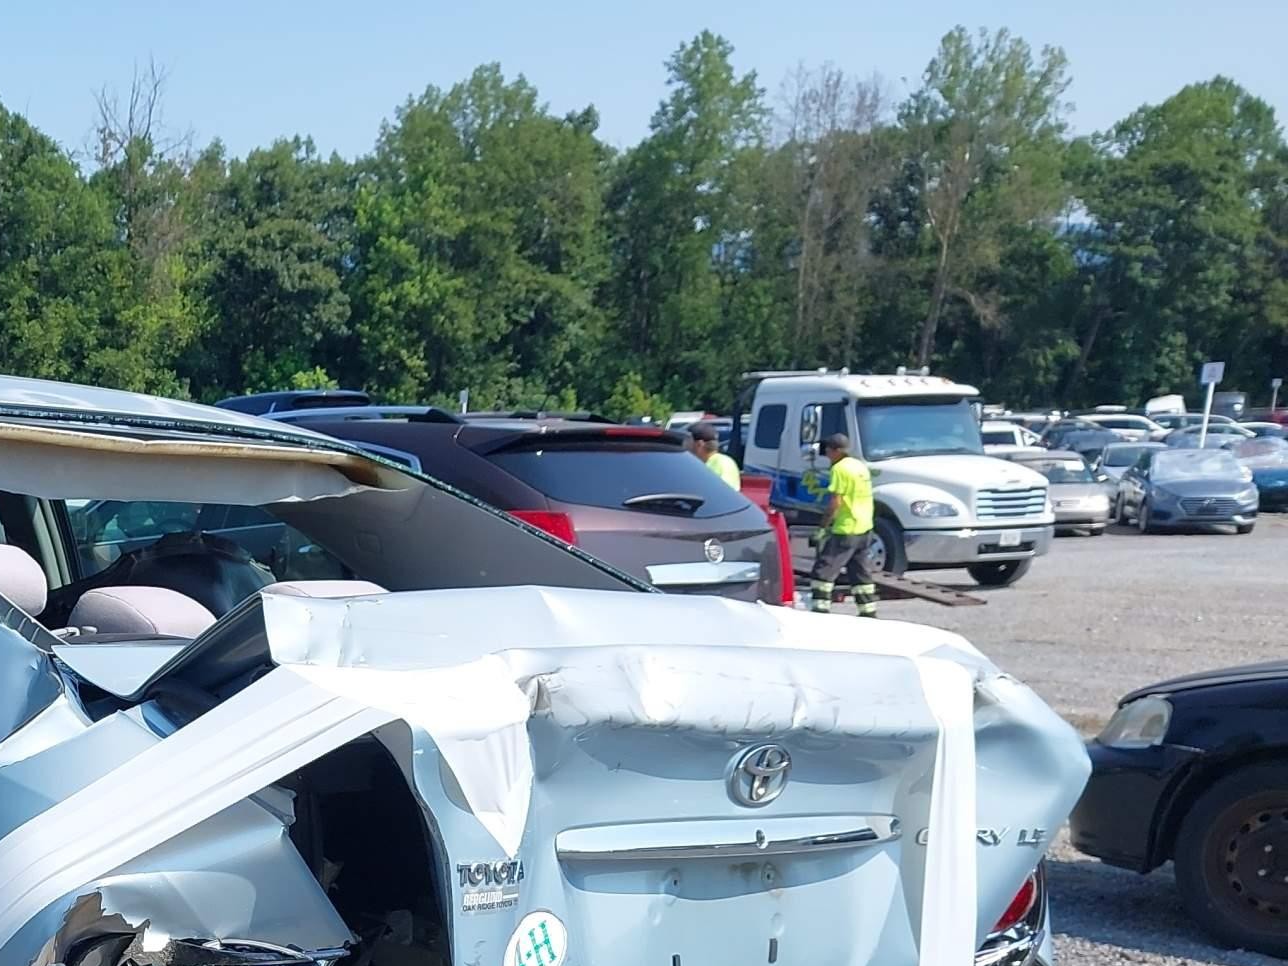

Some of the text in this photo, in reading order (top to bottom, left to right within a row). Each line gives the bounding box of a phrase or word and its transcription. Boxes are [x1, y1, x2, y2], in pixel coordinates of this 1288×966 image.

[915, 826, 1048, 847] CRY LE
[457, 859, 524, 887] TOYOTA
[462, 903, 476, 912] OAK
[477, 901, 496, 910] RIDGE
